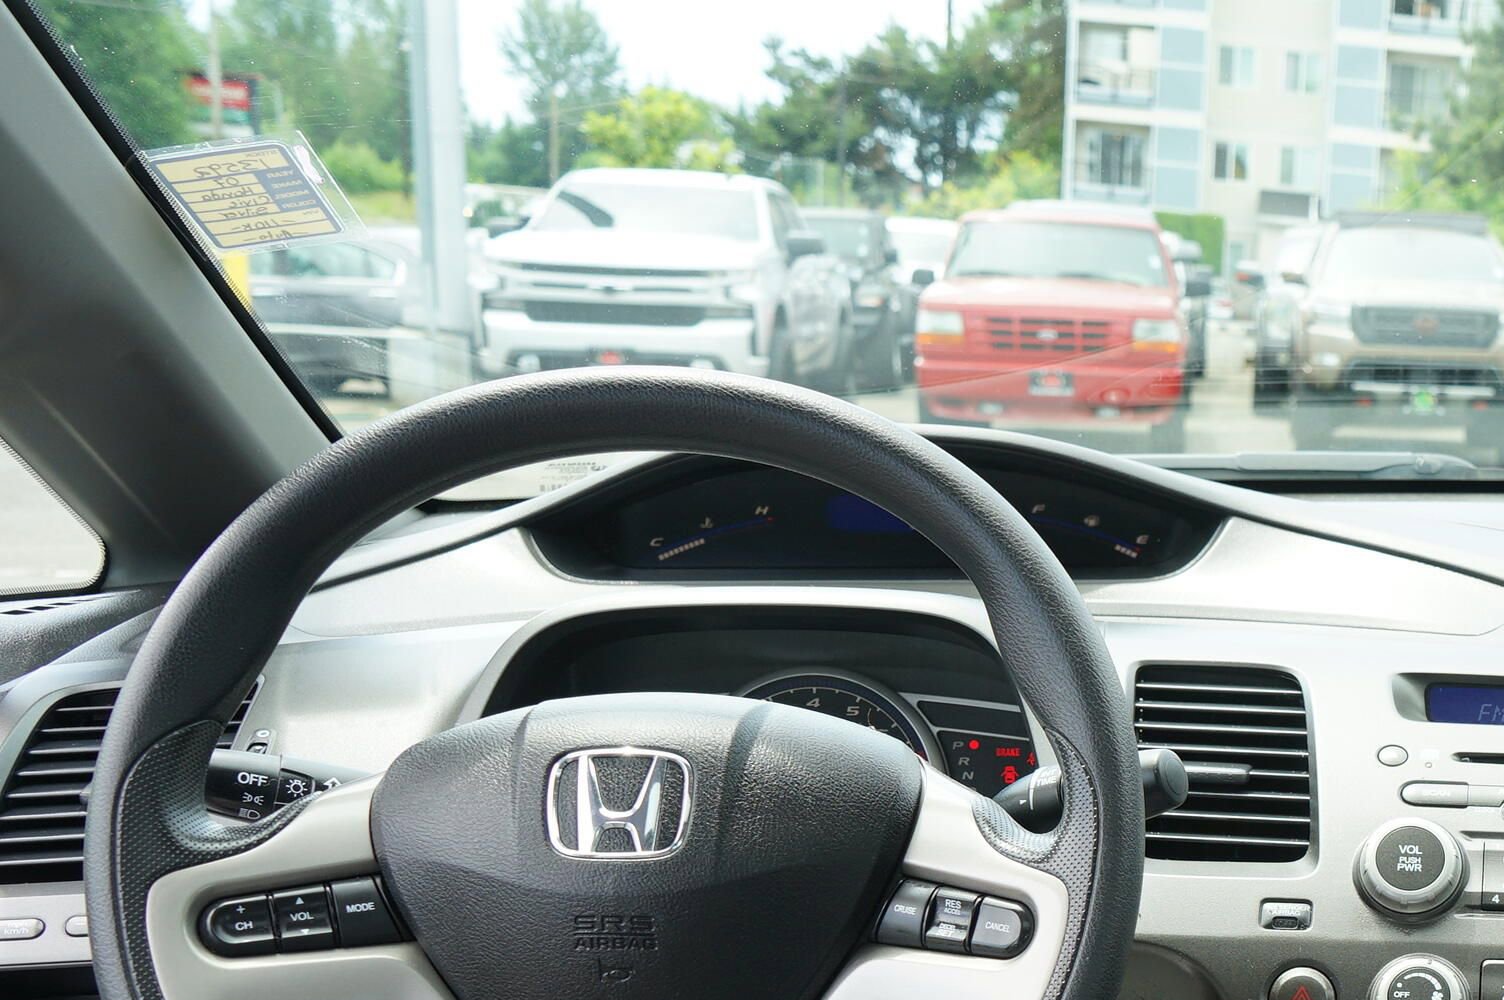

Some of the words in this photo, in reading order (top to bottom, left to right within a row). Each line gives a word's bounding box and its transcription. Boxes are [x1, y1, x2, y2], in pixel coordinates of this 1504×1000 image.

[806, 698, 820, 708] 4
[846, 706, 860, 716] 5
[952, 741, 964, 750] P
[958, 757, 971, 766] R
[237, 772, 268, 787] OFF
[962, 771, 974, 780] N
[1398, 845, 1423, 855] VOL
[1399, 856, 1421, 864] PUSH
[1397, 864, 1422, 872] PWR
[1491, 894, 1500, 904] 4
[346, 902, 375, 913] MODE
[945, 899, 961, 910] RES
[893, 904, 917, 916] CRUISE
[290, 911, 315, 922] VOL
[235, 920, 253, 931] CH
[573, 914, 656, 933] SRS
[985, 921, 1011, 933] CANCEL
[574, 936, 658, 950] AIRBAG
[1393, 991, 1410, 999] OFF
